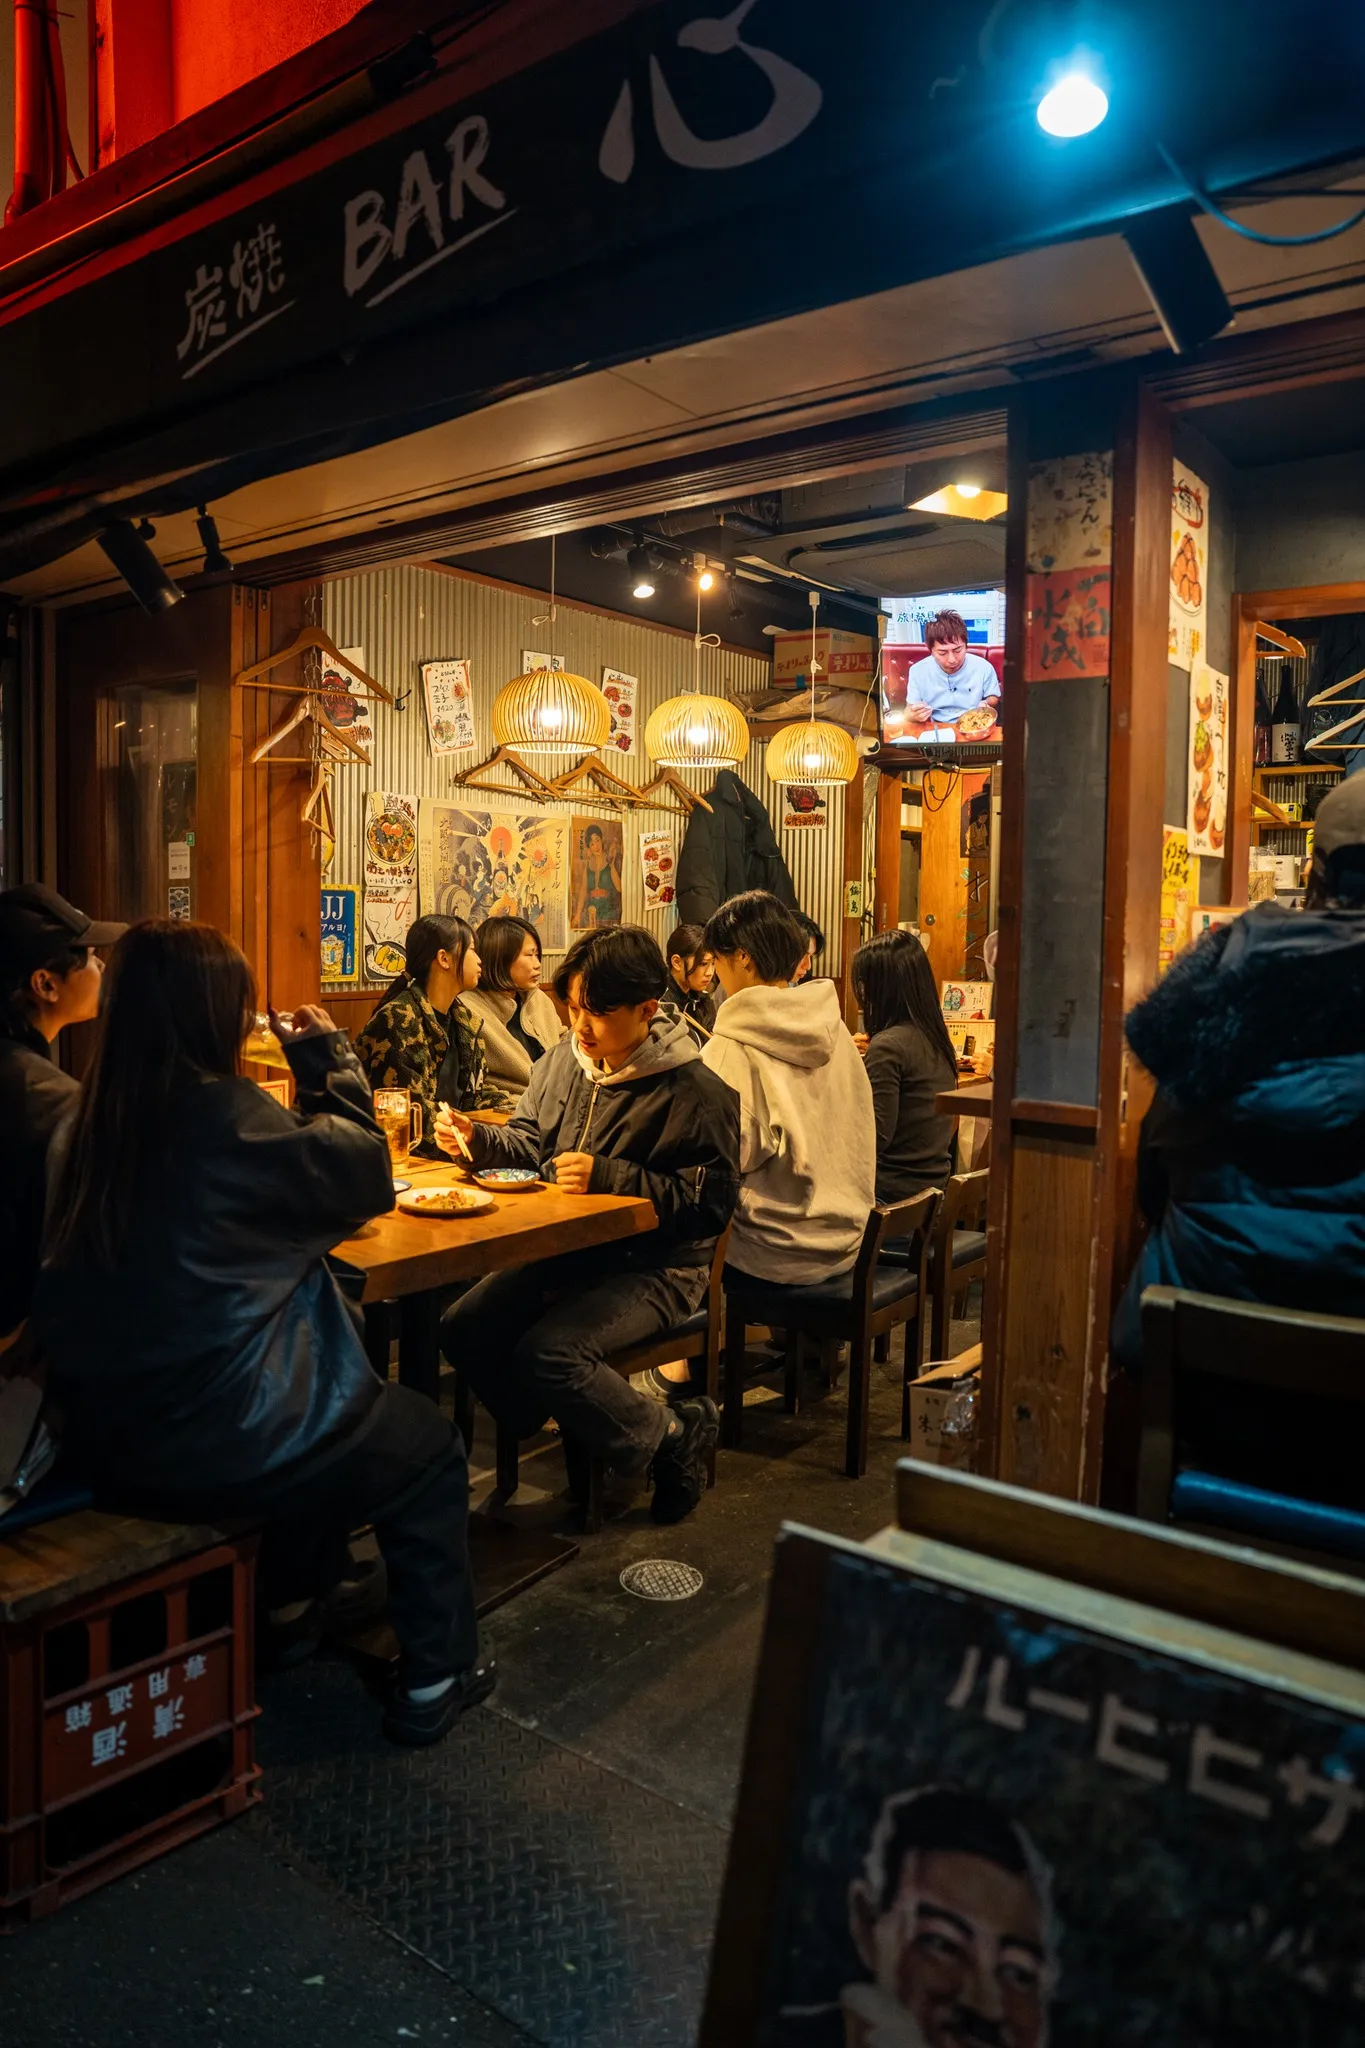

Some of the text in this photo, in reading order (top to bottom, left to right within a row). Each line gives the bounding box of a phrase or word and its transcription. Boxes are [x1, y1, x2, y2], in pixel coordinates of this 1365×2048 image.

[342, 114, 505, 296] BAR
[551, 828, 564, 890] アサヒビール
[90, 1695, 185, 1767] 清酒
